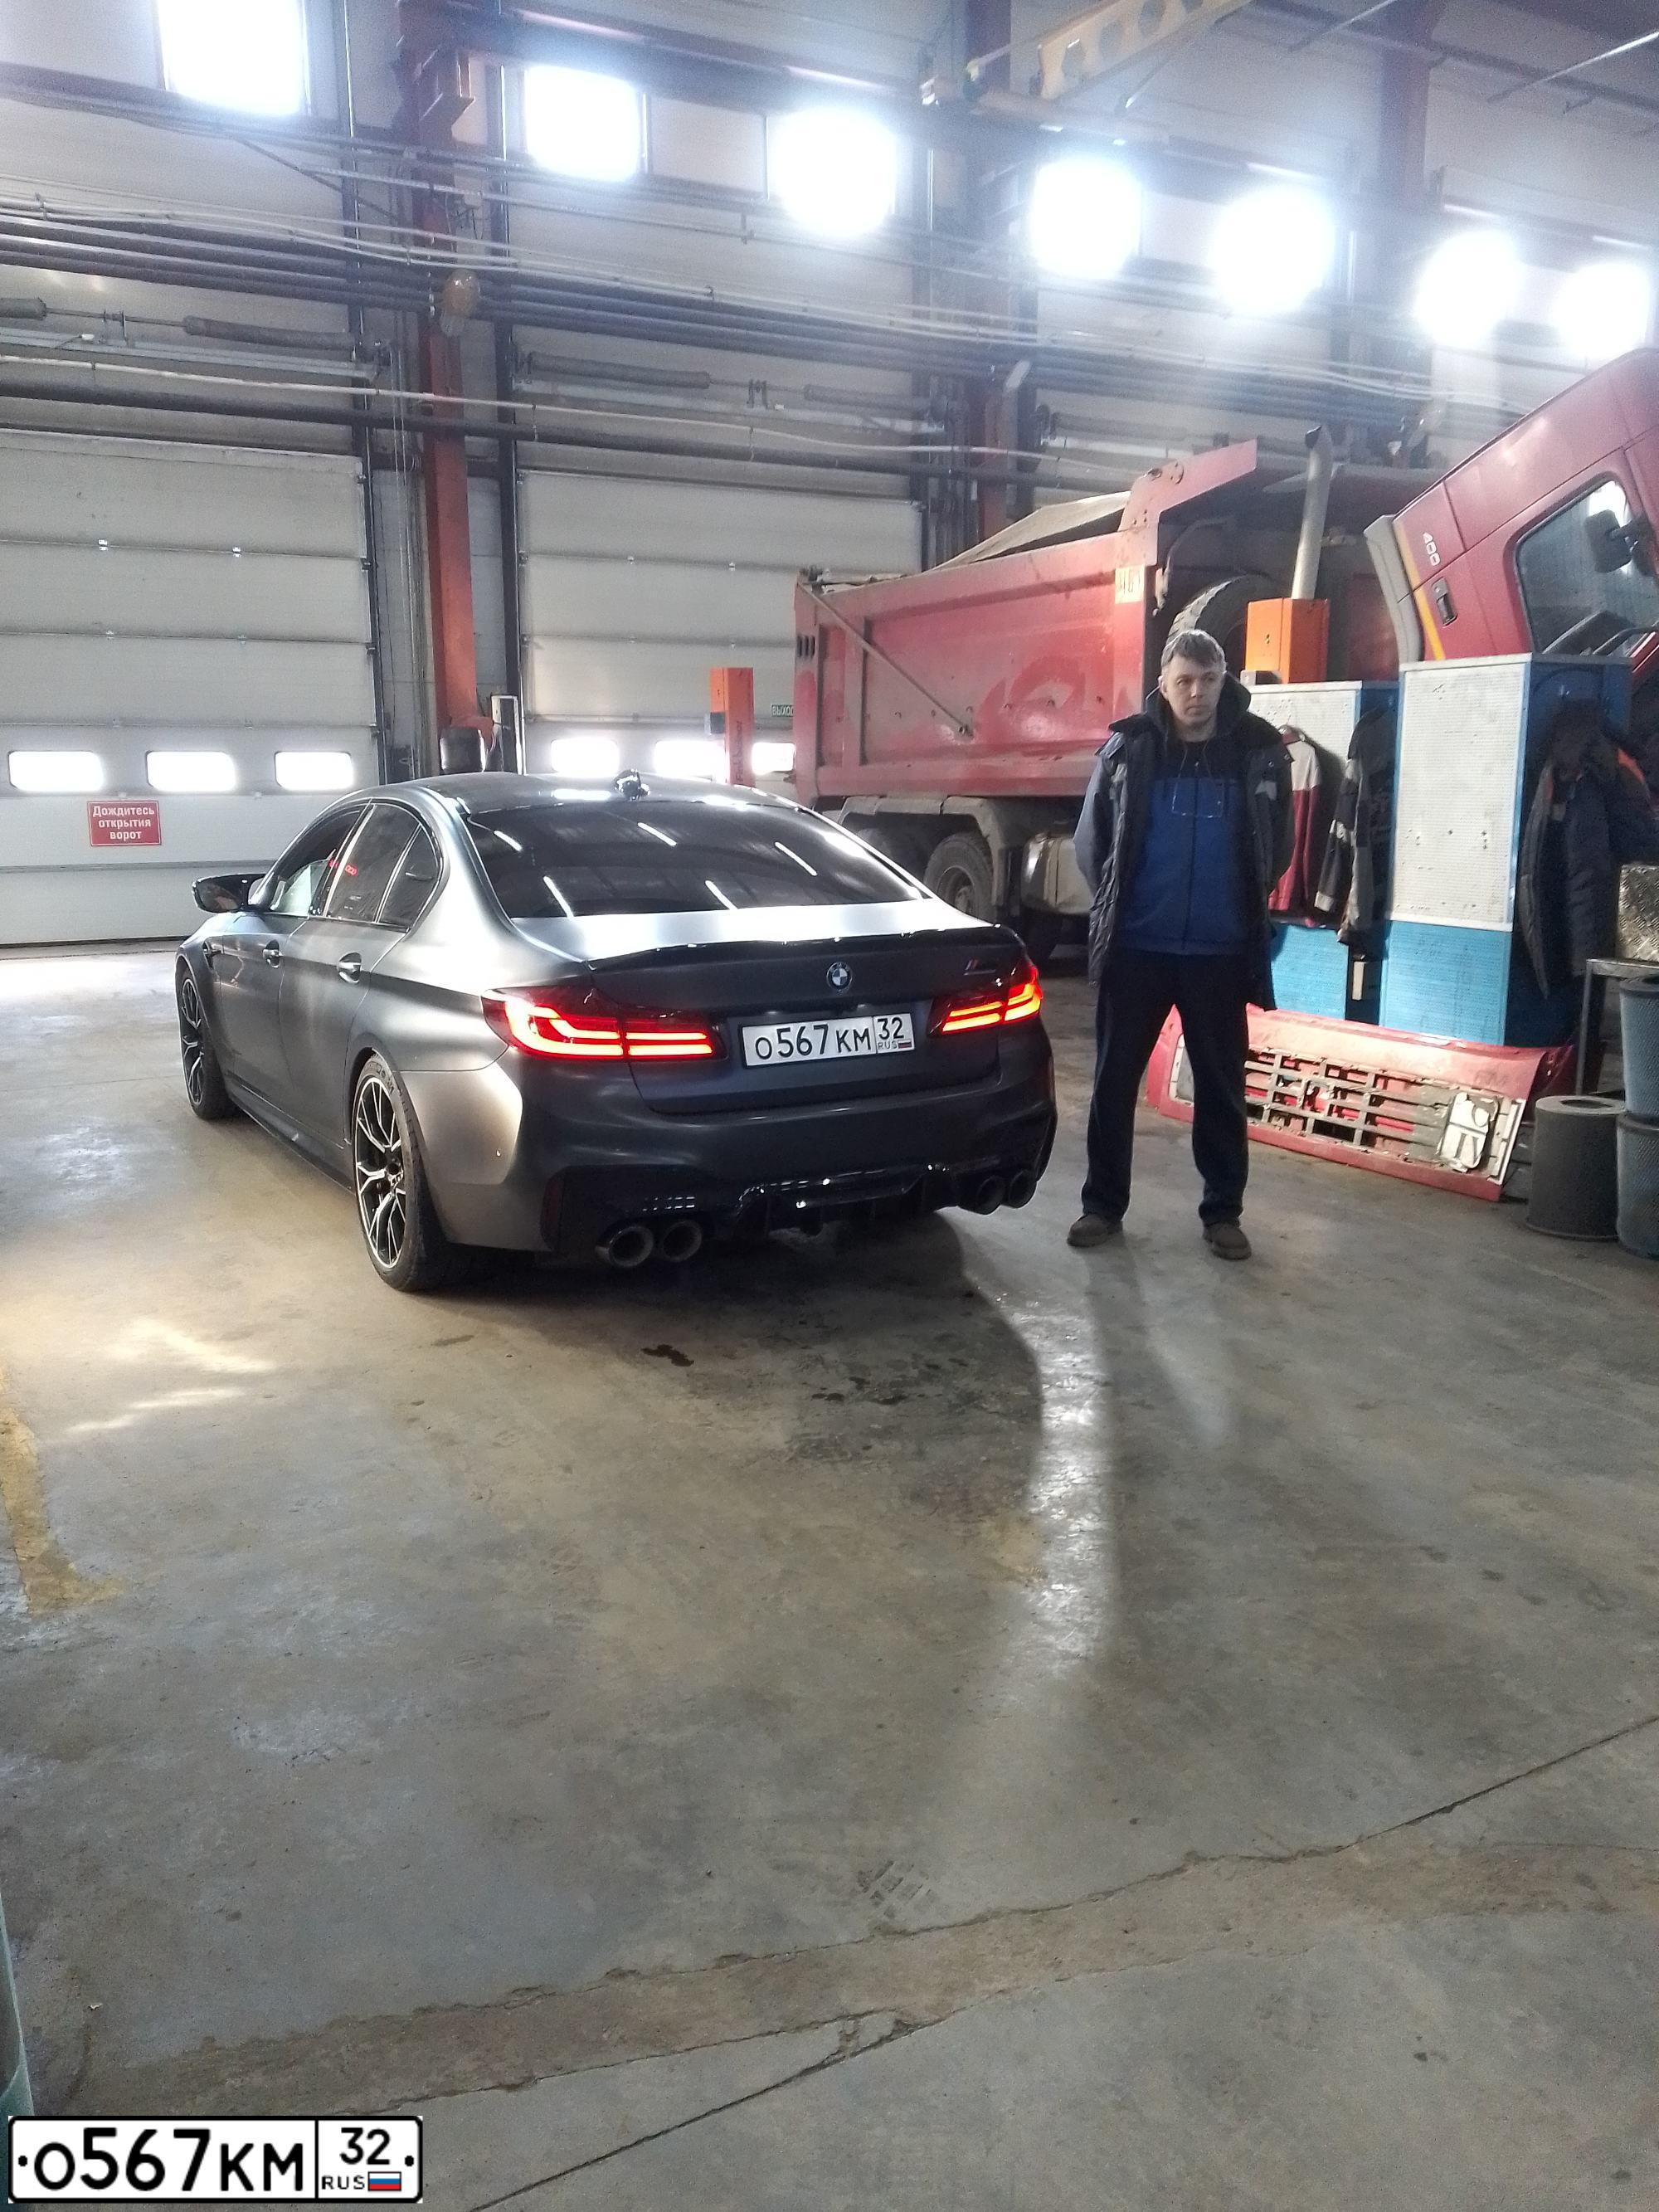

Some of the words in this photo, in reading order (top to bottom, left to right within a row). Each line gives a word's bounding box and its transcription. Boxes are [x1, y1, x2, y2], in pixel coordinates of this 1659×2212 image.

[1423, 532, 1441, 566] 400
[772, 705, 794, 716] ВЫХО
[92, 806, 155, 817] Дождитесь
[98, 819, 151, 829] открытия
[109, 831, 142, 841] ворот
[877, 1016, 904, 1040] 32
[878, 1040, 898, 1050] RUS
